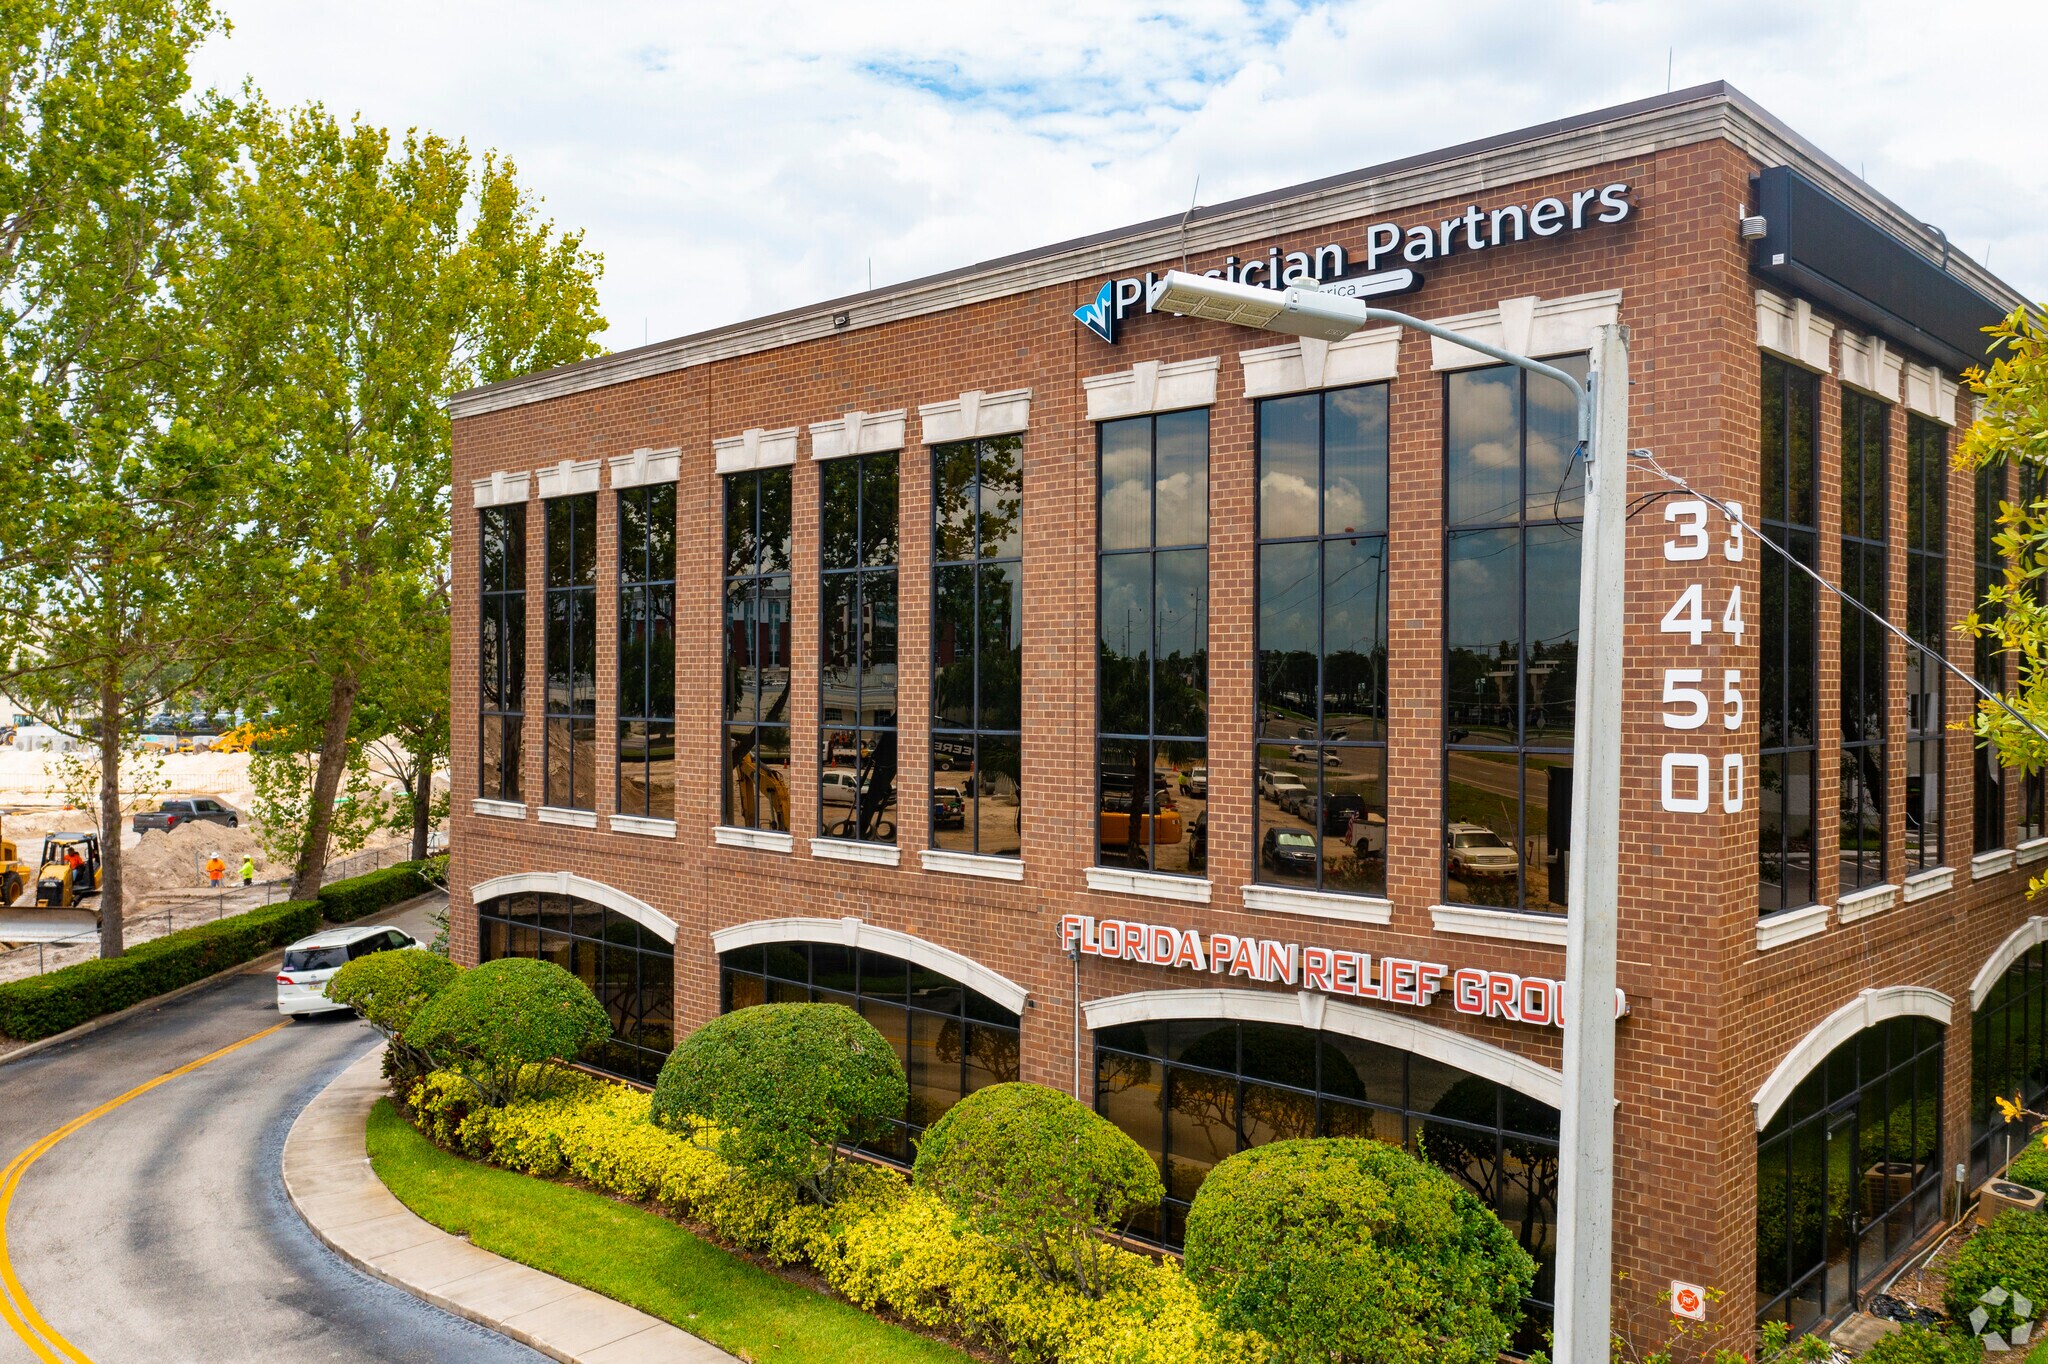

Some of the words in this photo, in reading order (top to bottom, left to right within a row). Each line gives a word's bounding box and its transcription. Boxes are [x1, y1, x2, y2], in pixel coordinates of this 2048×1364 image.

[1367, 182, 1630, 270] Partners
[1062, 914, 1207, 970] FLORIDA
[1210, 933, 1298, 984] PAIN
[1303, 946, 1448, 1006] RELIEF
[1453, 967, 1625, 1028] GRO
